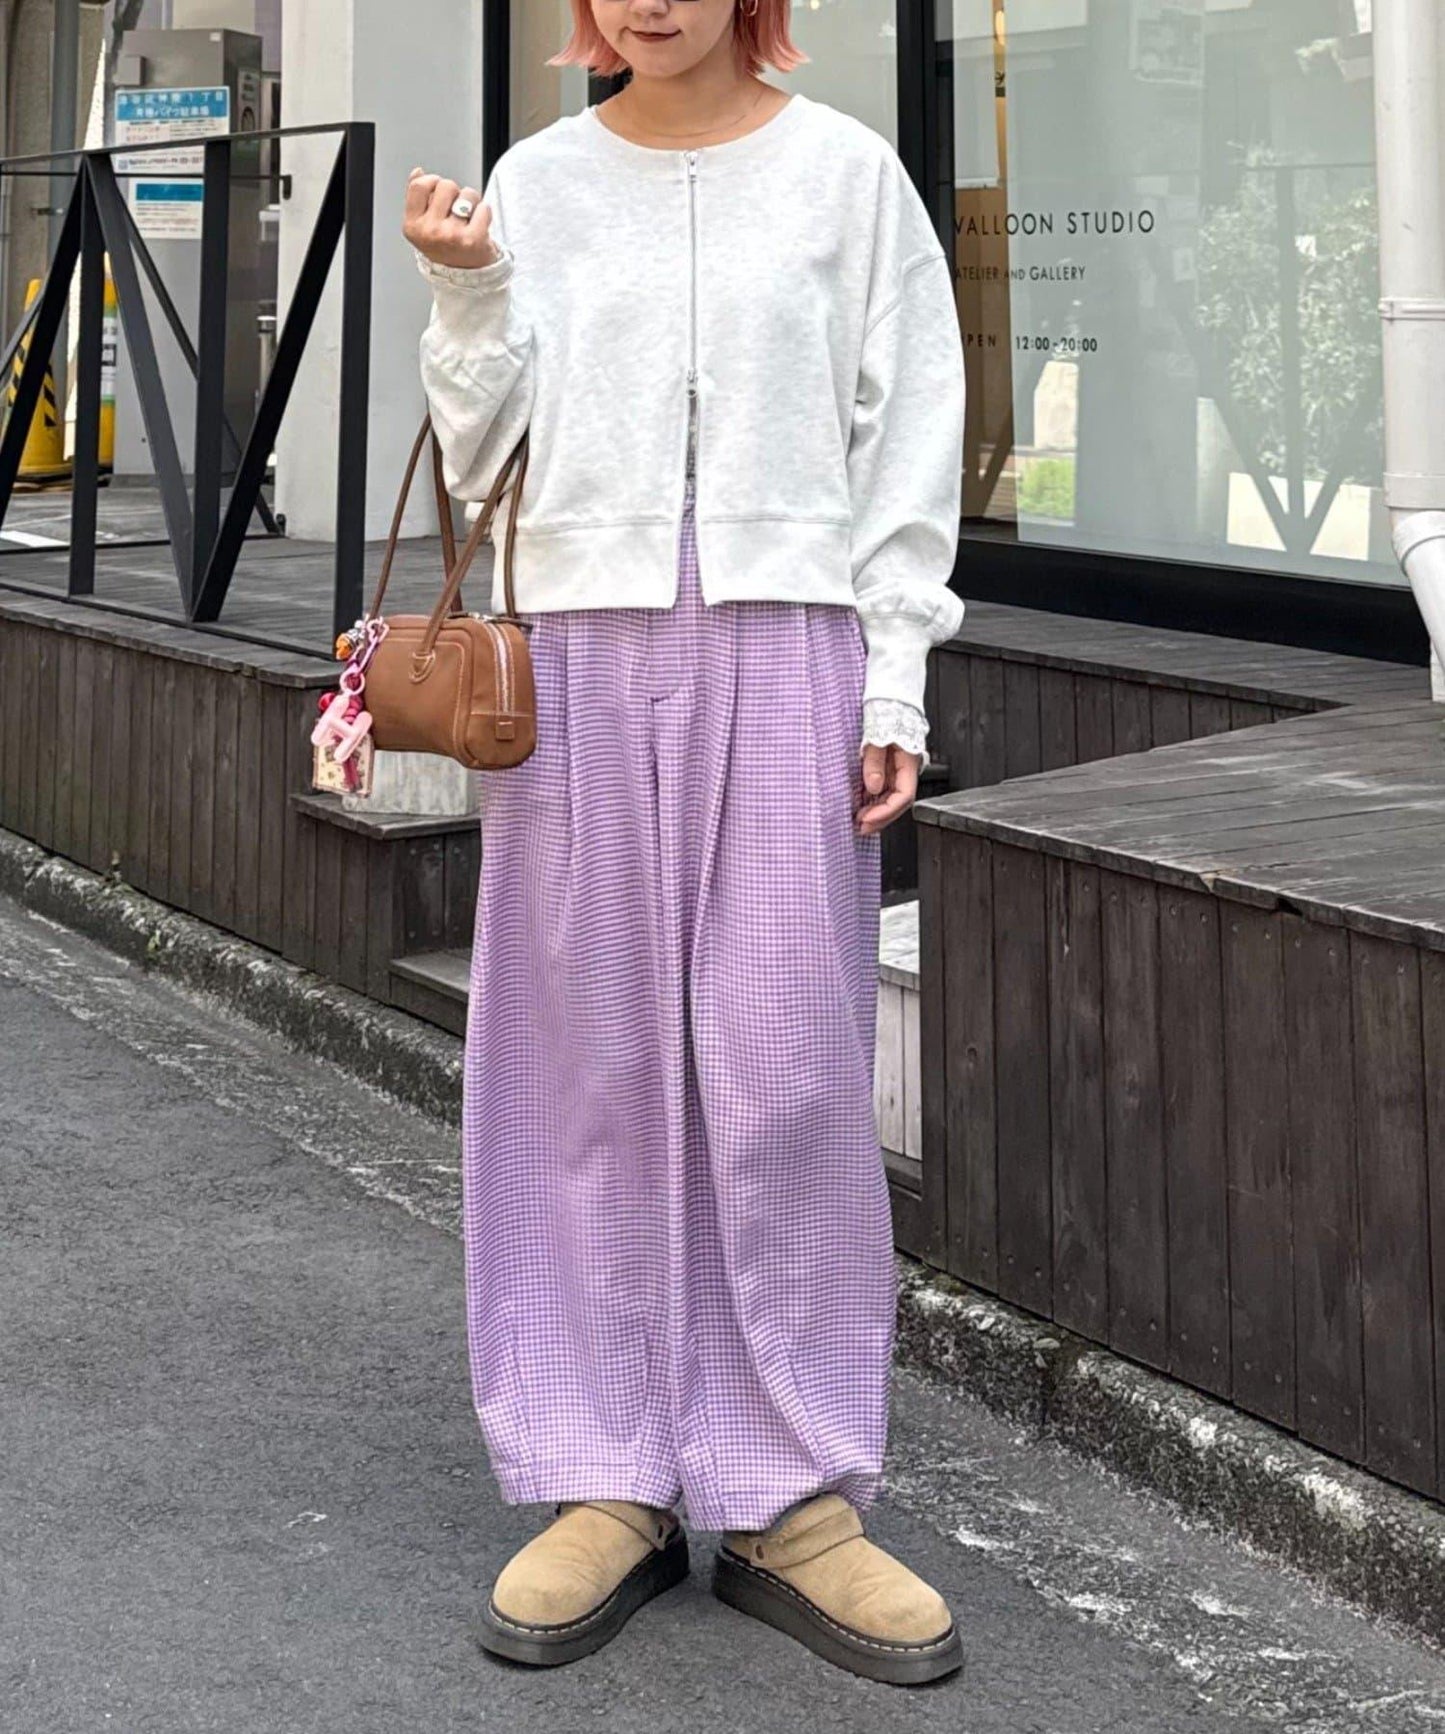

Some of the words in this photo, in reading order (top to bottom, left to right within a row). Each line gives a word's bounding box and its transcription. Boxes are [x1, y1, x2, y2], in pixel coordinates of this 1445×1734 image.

[954, 213, 1053, 235] VALLOON
[1067, 210, 1154, 234] STUDIO
[956, 266, 999, 281] ATELIER
[1004, 268, 1025, 280] AND
[1030, 265, 1086, 281] GALLERY
[964, 334, 996, 348] PEN
